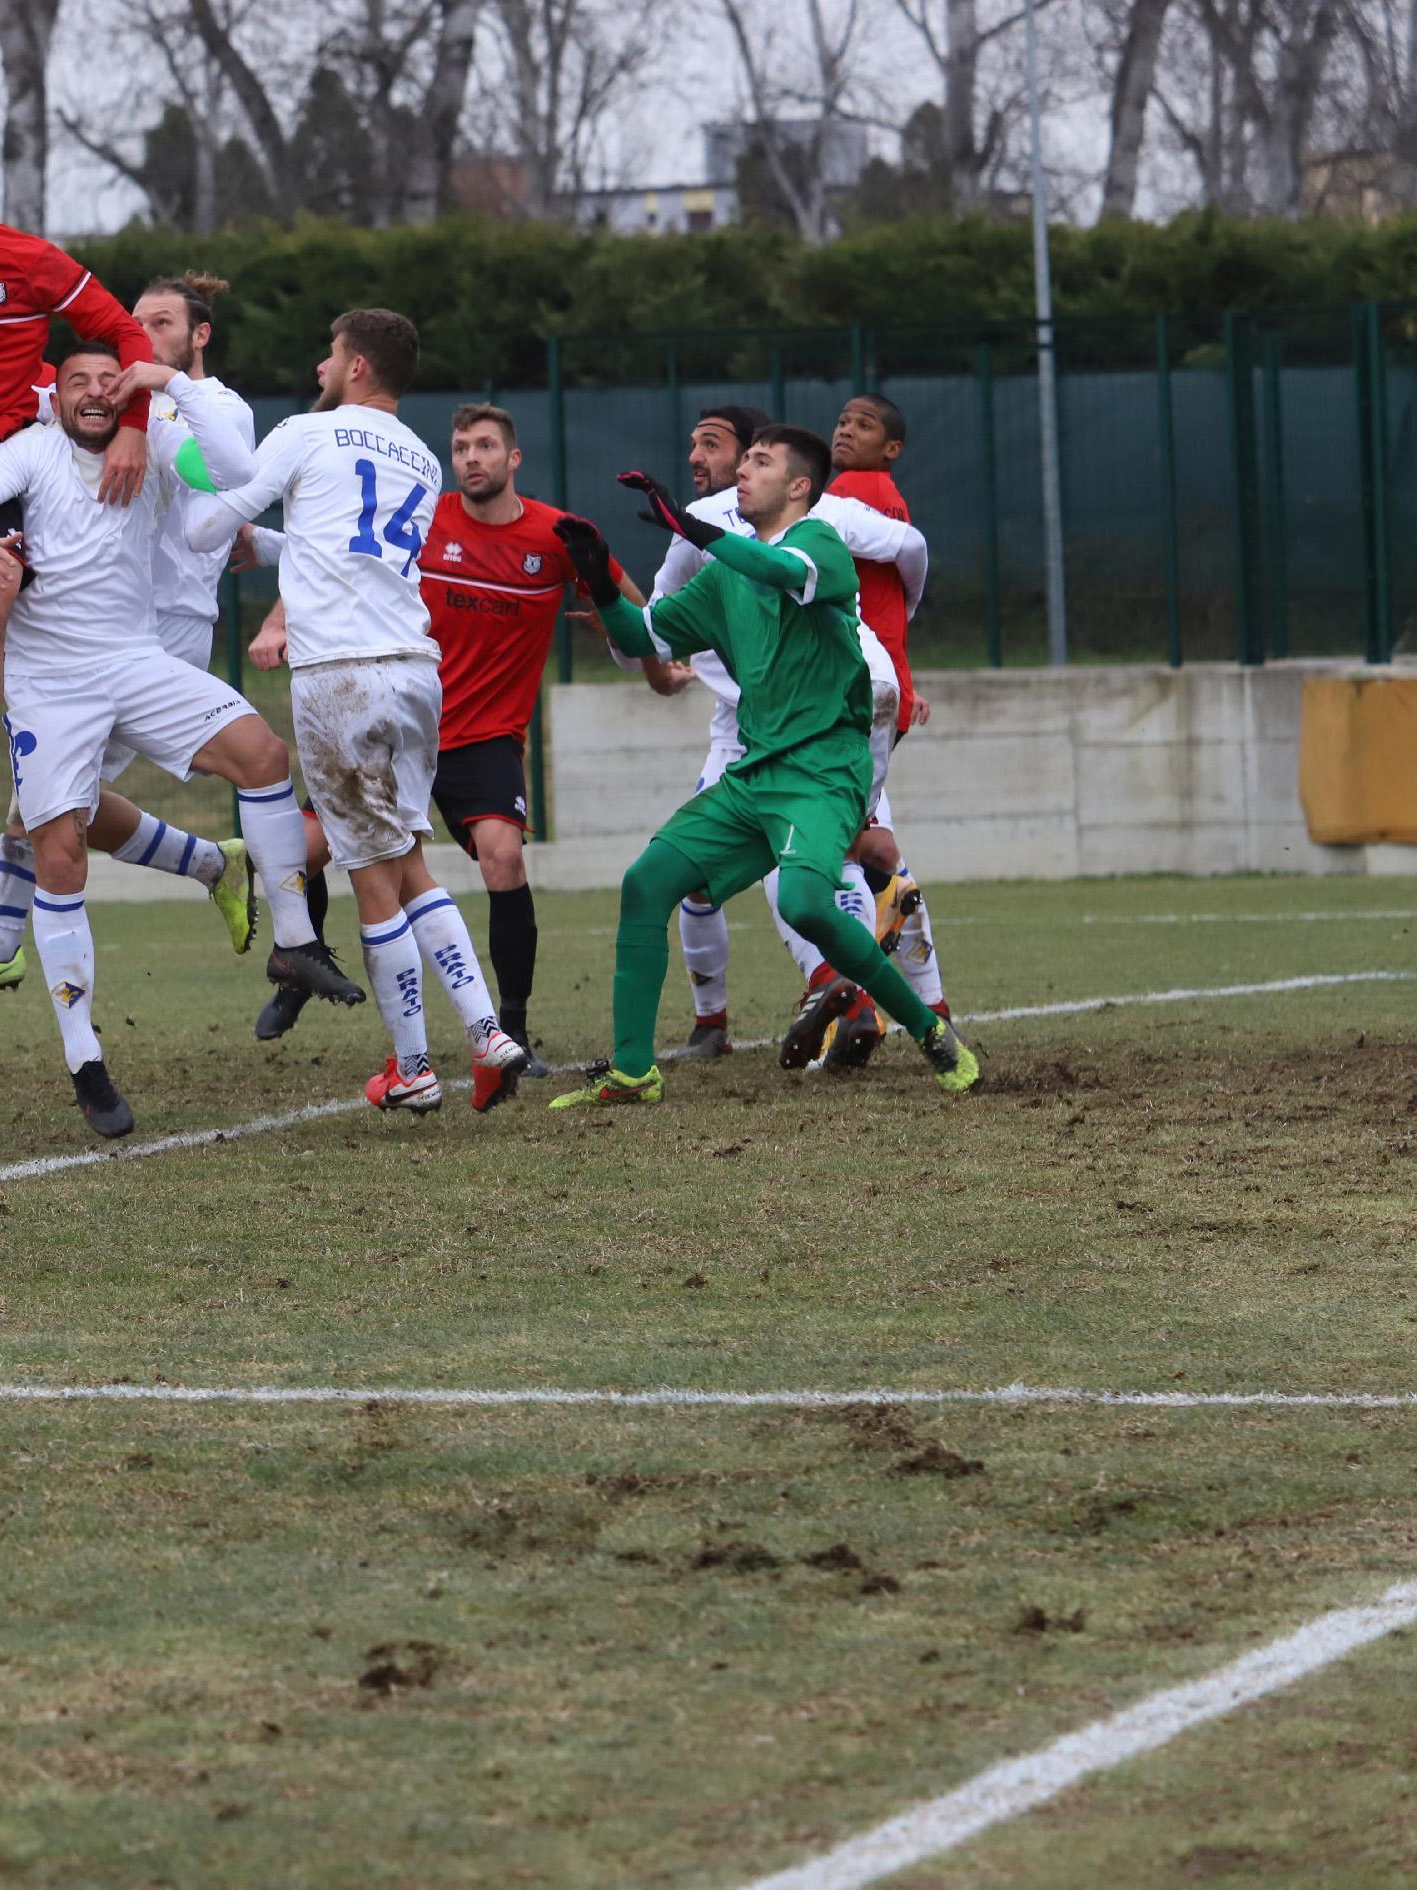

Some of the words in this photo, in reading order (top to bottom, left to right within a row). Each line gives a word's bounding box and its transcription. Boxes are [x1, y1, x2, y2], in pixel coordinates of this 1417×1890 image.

[349, 458, 423, 579] 14
[446, 586, 520, 617] texcart
[433, 943, 475, 990] PRATO
[396, 967, 422, 1018] PRATO
